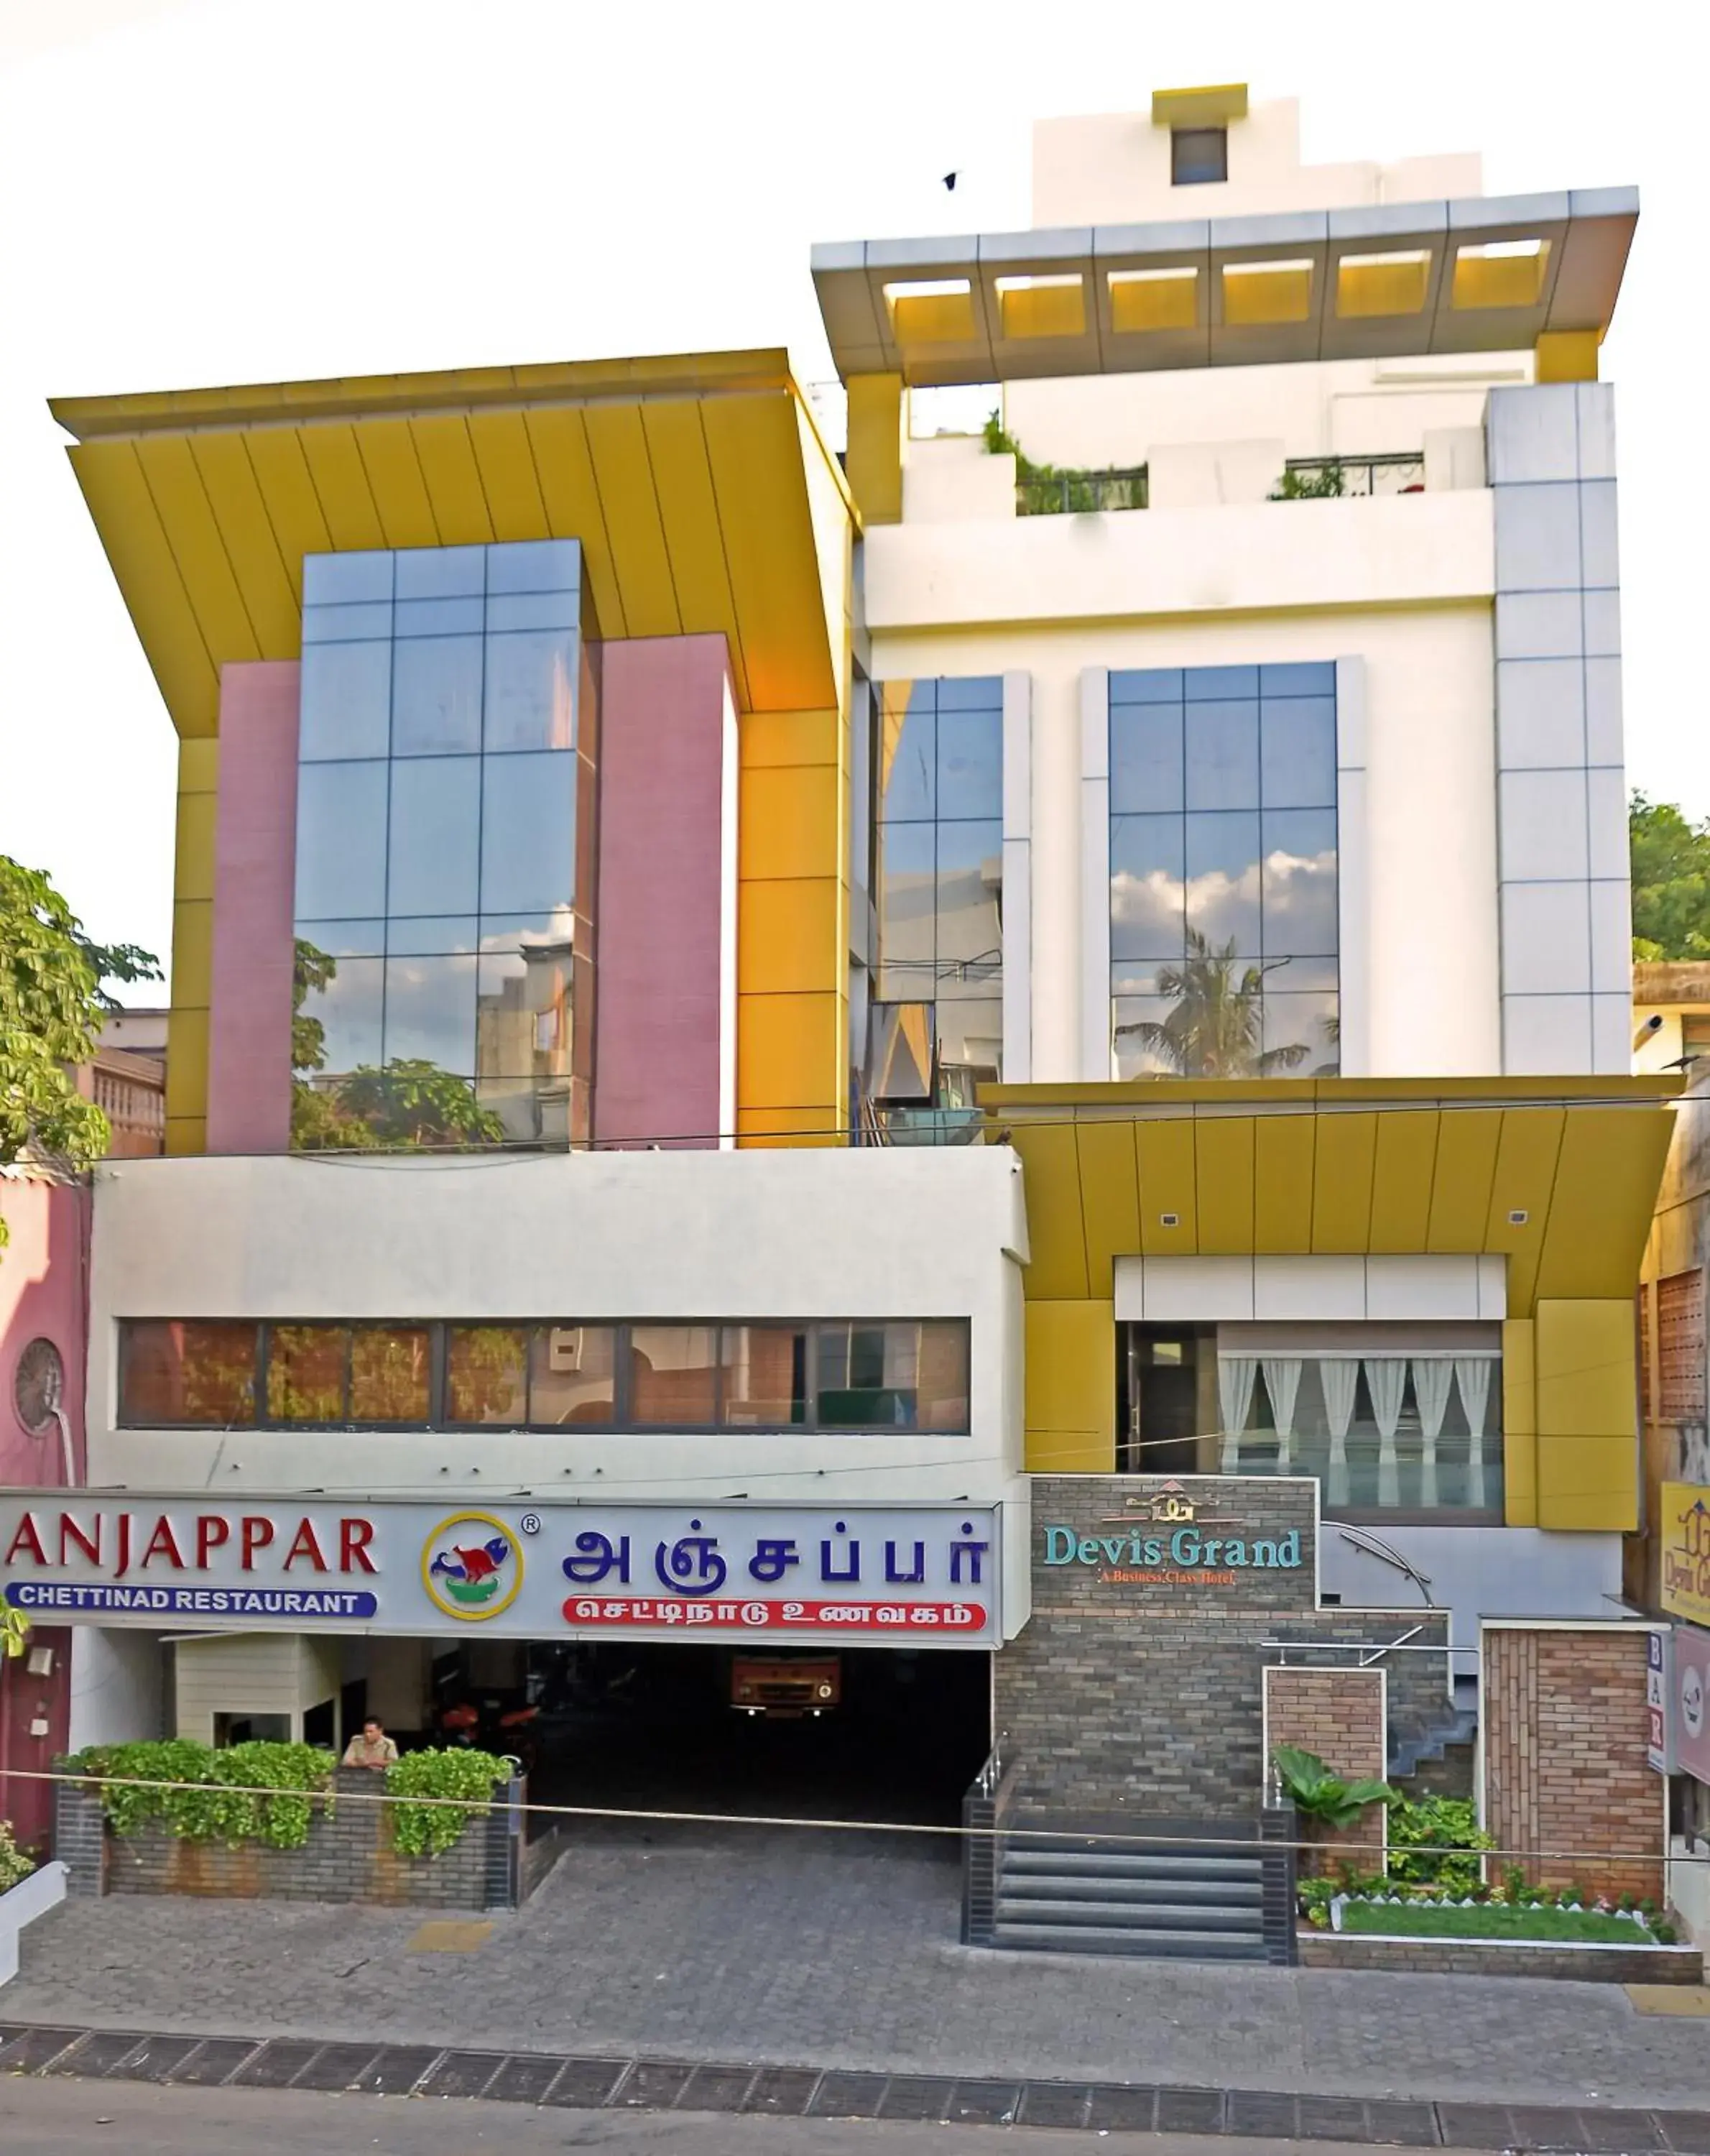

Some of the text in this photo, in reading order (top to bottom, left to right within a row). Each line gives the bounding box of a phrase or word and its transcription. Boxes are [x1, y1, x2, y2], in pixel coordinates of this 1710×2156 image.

[6, 1512, 380, 1578] ANJAPPAR
[562, 1519, 989, 1595] அஞ்சப்பர்
[1044, 1526, 1303, 1568] Devis Grand
[1114, 1570, 1163, 1583] Business
[1165, 1571, 1197, 1583] Class
[1201, 1572, 1234, 1584] Hotel
[19, 1585, 359, 1613] CHETTINAD RESTAURANT
[576, 1600, 972, 1626] செட்டிநாடு உணவகம்
[1650, 1636, 1662, 1745] BAR
